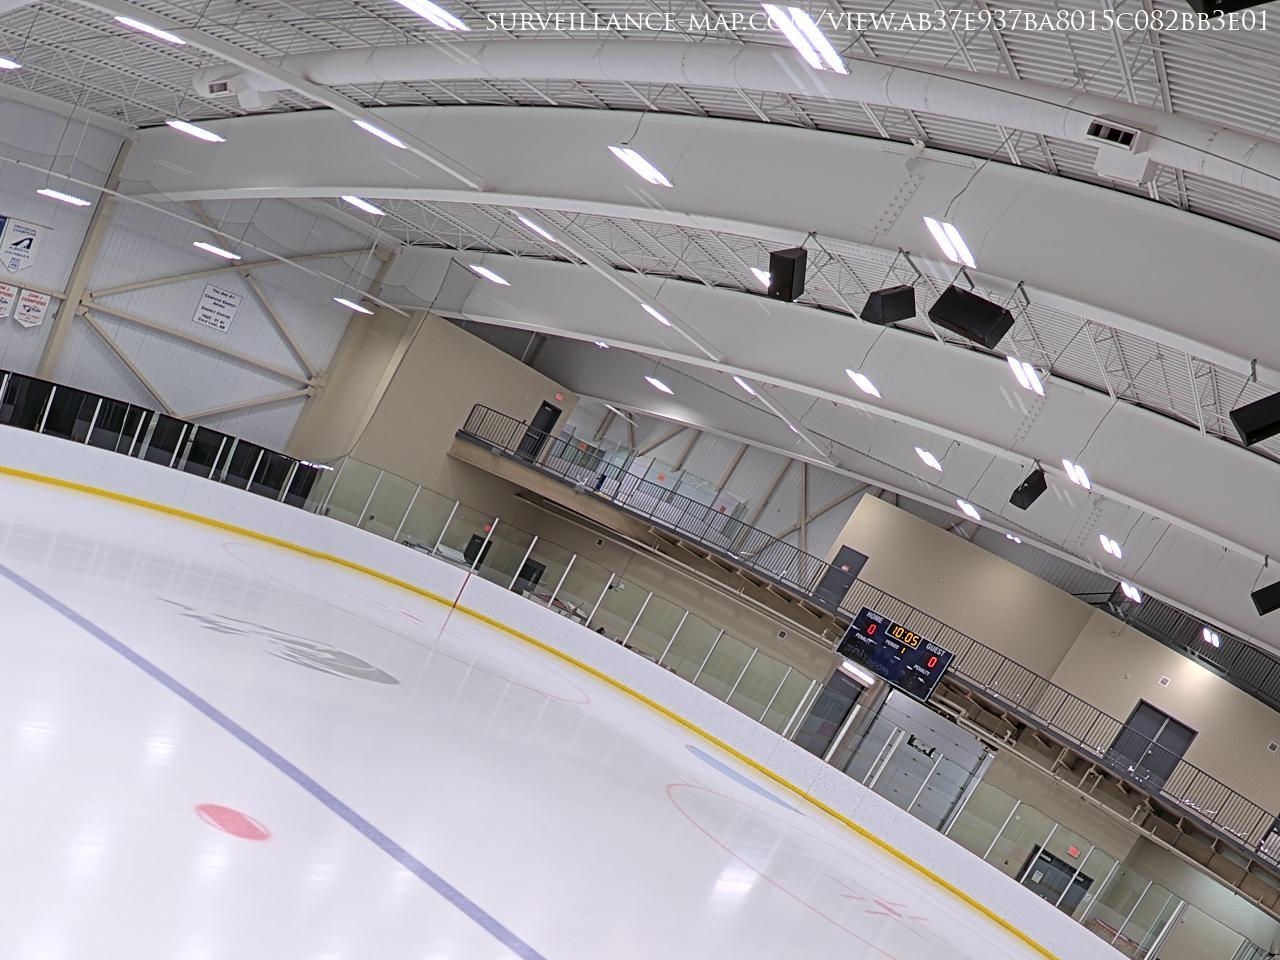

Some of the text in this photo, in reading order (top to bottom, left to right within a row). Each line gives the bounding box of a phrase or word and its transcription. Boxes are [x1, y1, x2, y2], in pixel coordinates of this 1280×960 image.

[866, 611, 884, 624] HOME
[867, 623, 877, 635] 0
[892, 626, 920, 646] 10:05
[926, 642, 946, 657] GUEST
[927, 656, 938, 668] 0
